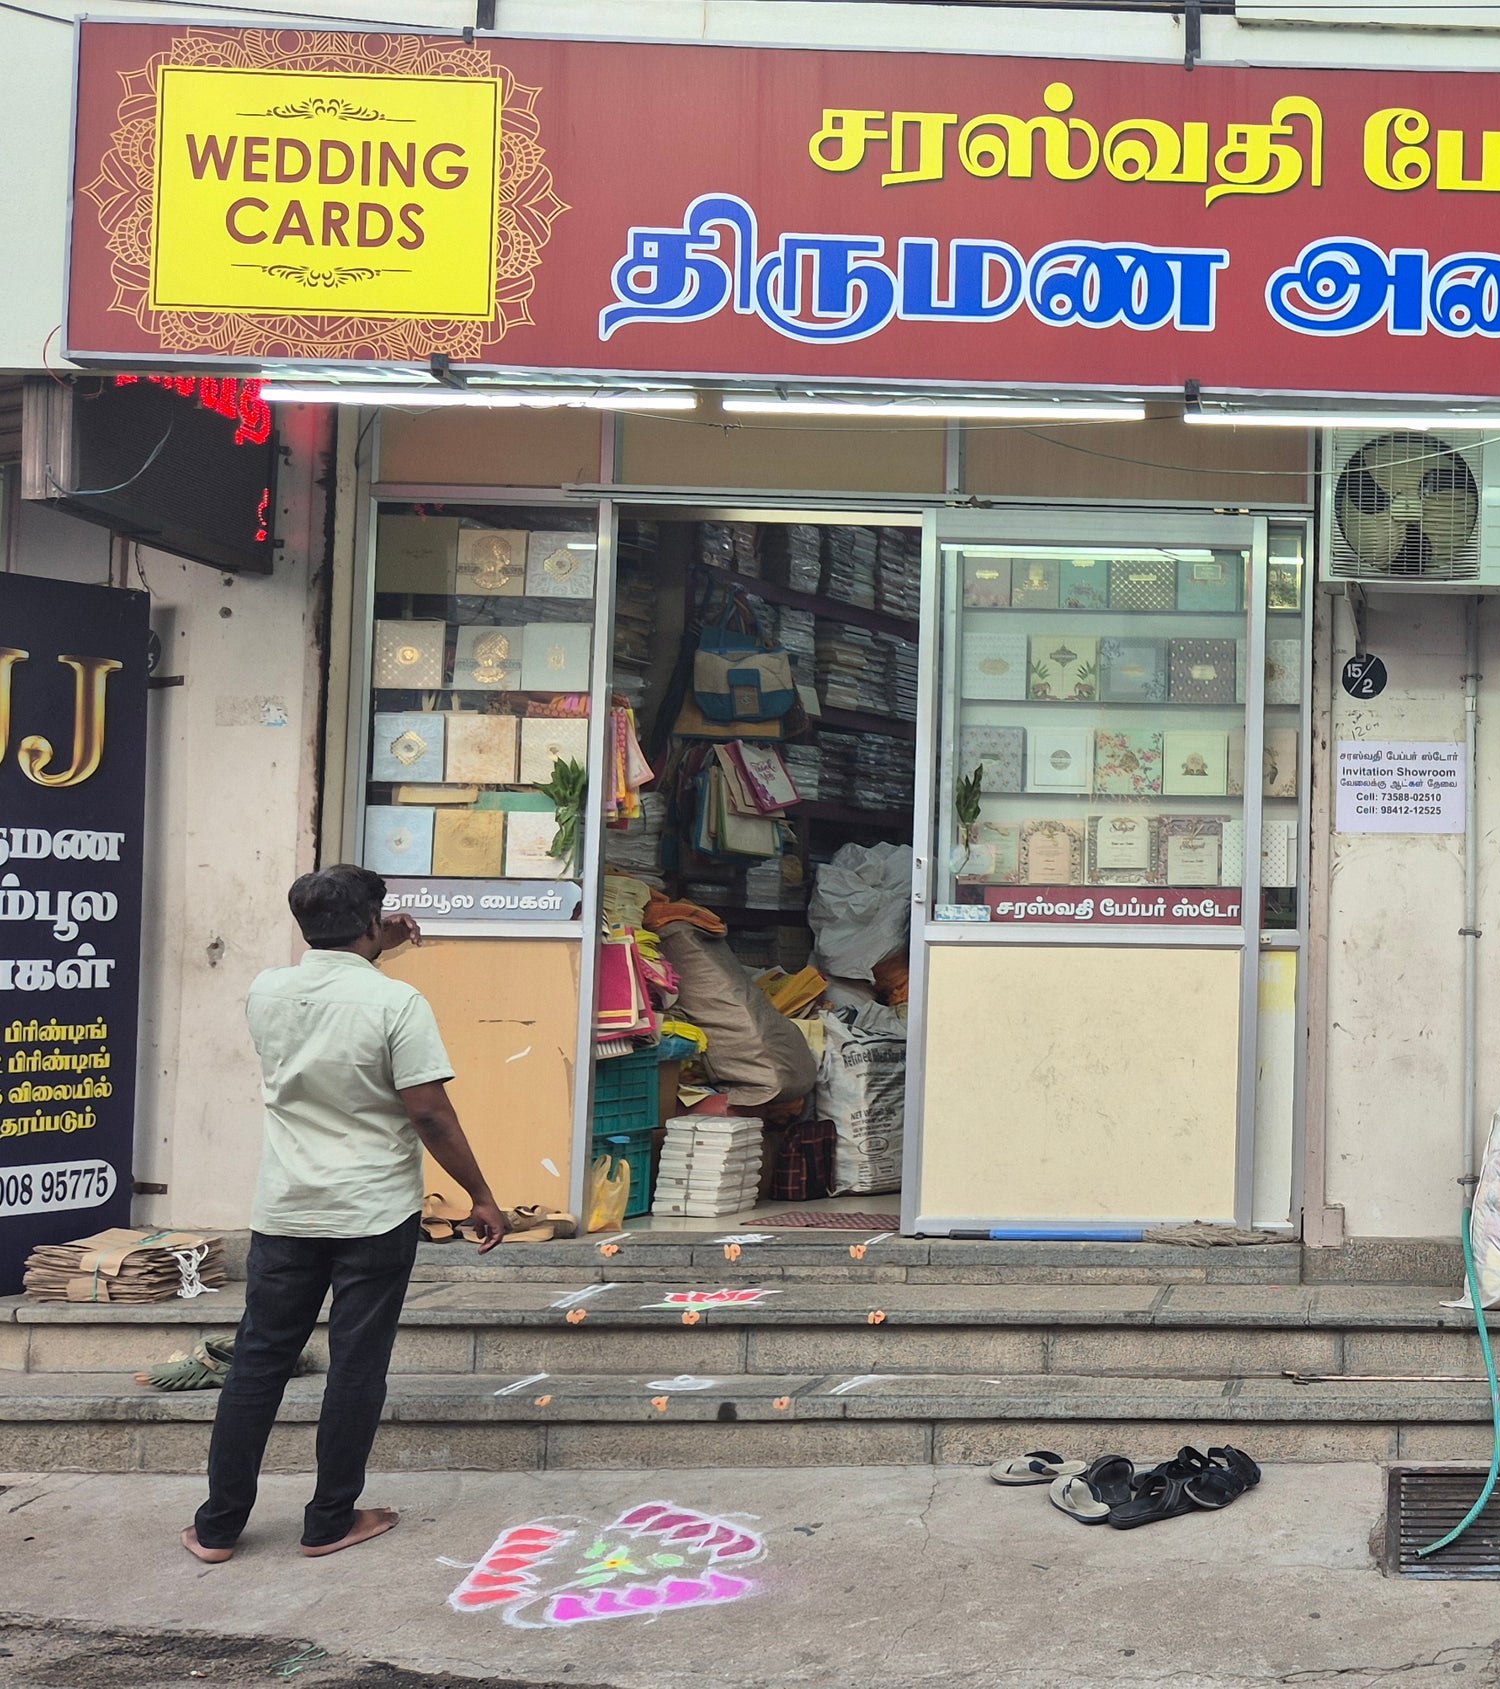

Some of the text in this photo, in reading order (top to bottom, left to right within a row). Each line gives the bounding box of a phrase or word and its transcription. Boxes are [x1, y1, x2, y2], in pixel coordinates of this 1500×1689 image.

[808, 81, 1323, 209] சரஸ்வதி
[186, 133, 470, 190] WEDDING
[225, 197, 426, 250] CARDS
[599, 192, 1229, 344] திருமண
[1347, 663, 1362, 678] 15
[1362, 678, 1373, 693] 2
[1339, 750, 1458, 762] சரஸ்வதி பேப்பர் ஸ்டோர்
[1342, 766, 1456, 777] Invitation Showroom
[1427, 778, 1457, 789] தேவை
[1356, 792, 1442, 802] Cell: 73588-02510
[1356, 805, 1442, 815] Cell: 98412-12525
[381, 887, 562, 915] தாம்பூல பைகள்
[996, 896, 1094, 920] சரஸ்வதி
[1100, 896, 1166, 918] பேப்பர்
[4, 1016, 108, 1044] பிரிண்டிங்
[8, 1045, 111, 1074] பிரிண்டிங்
[8, 1075, 113, 1104] விலையில்
[41, 1165, 108, 1204] 95775
